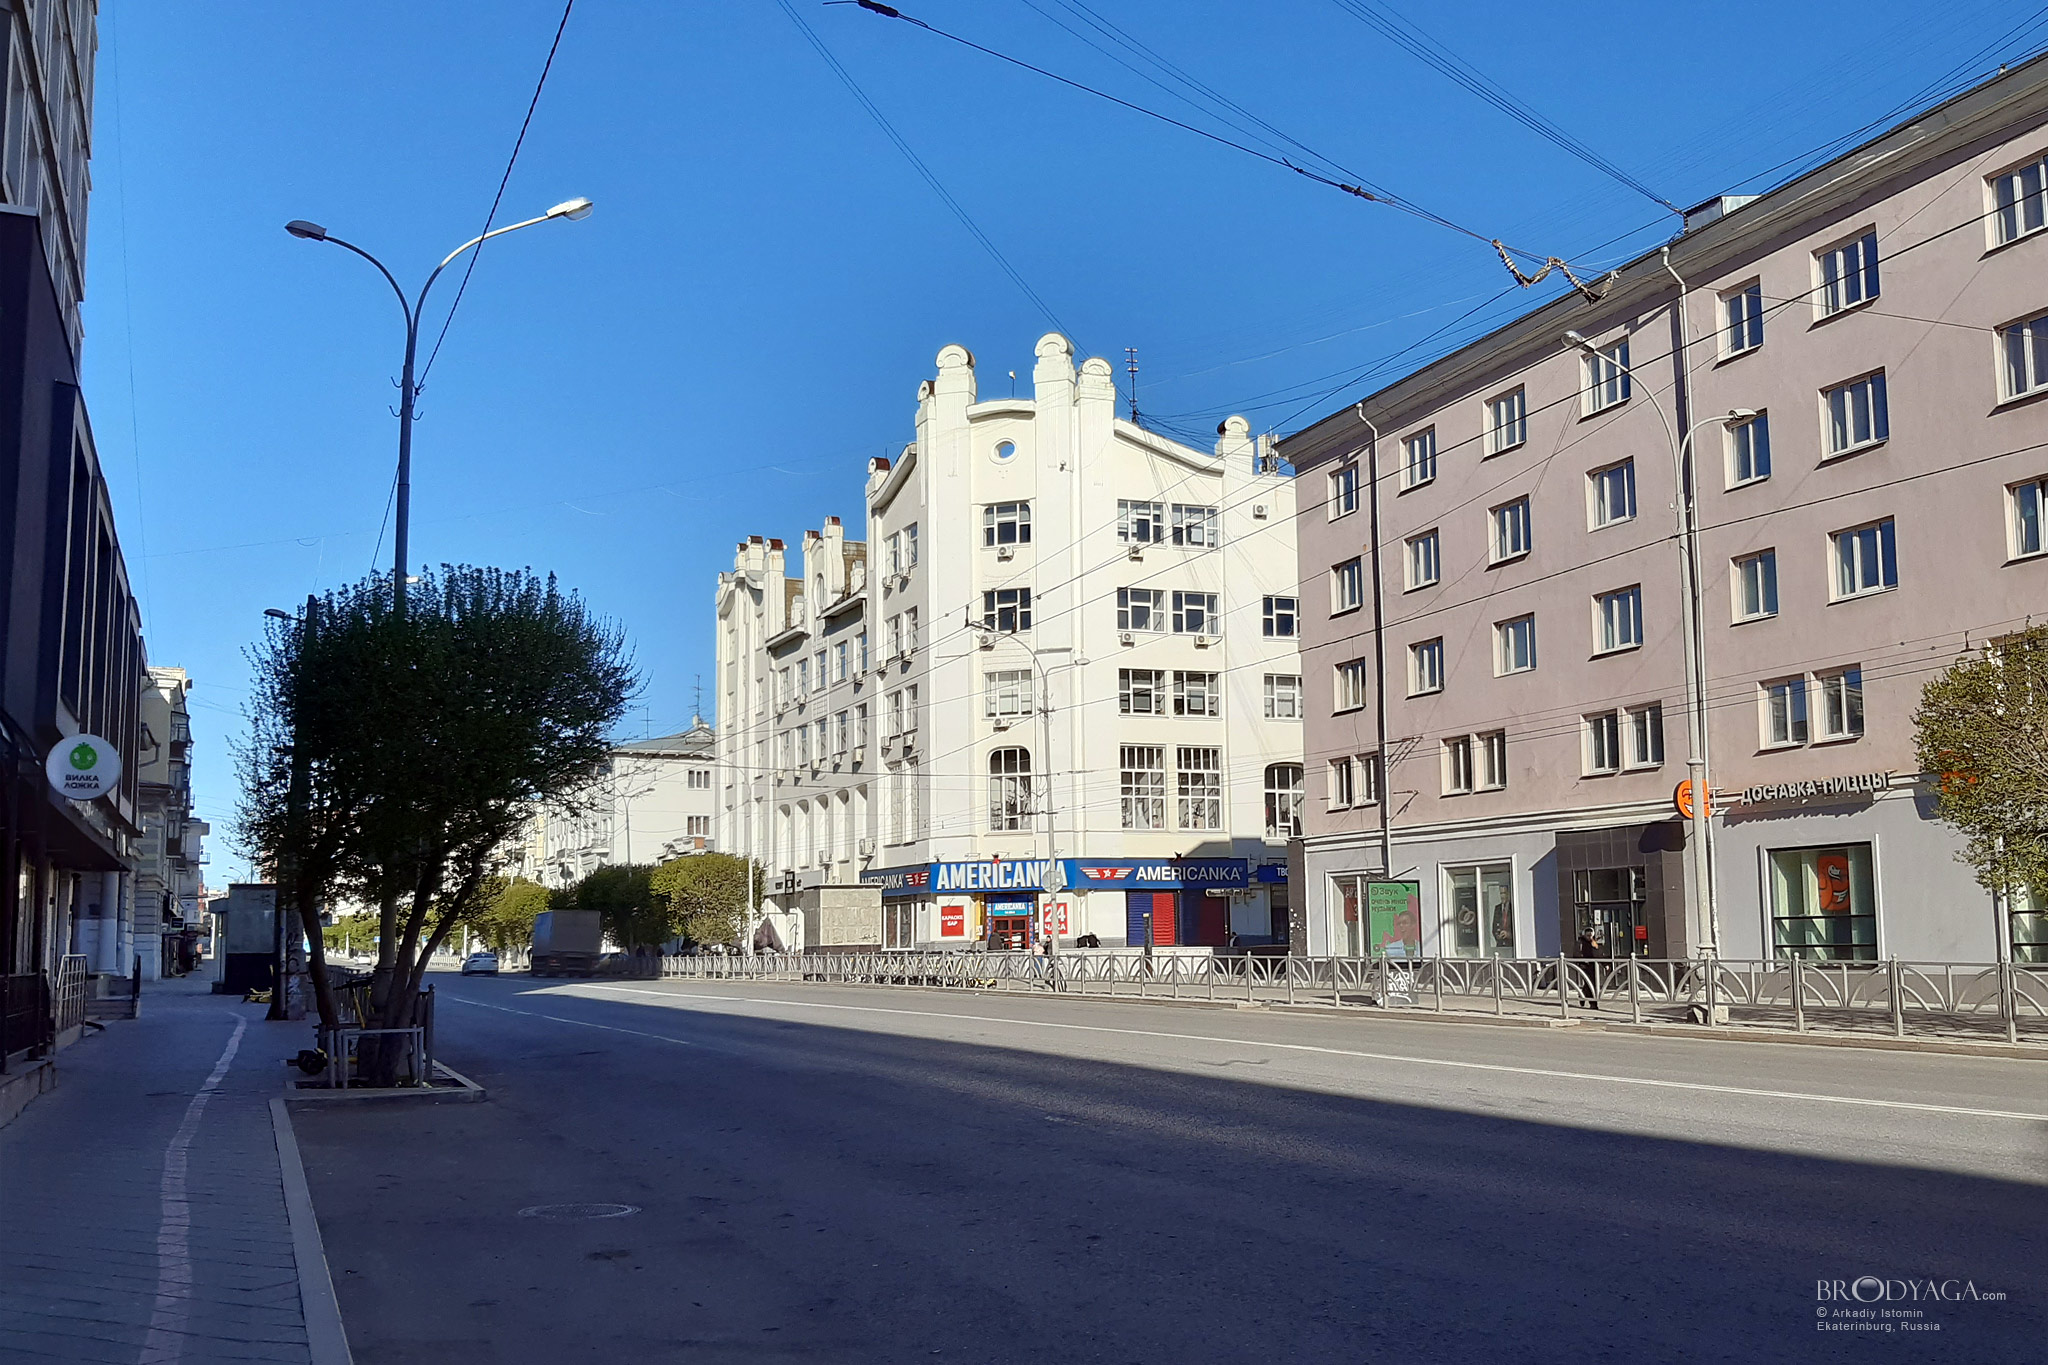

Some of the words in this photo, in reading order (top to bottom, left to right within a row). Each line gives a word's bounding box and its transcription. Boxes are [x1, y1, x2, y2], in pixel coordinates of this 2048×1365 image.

[65, 774, 99, 782] ВИЛКА
[64, 782, 100, 790] ЛОЖКА
[1740, 780, 1817, 806] ДОСТАВКА
[1823, 772, 1890, 794] ПИЦЦЫ
[1136, 866, 1240, 881] AMERICANKA
[1380, 887, 1399, 896] Звук
[1044, 905, 1066, 922] 24
